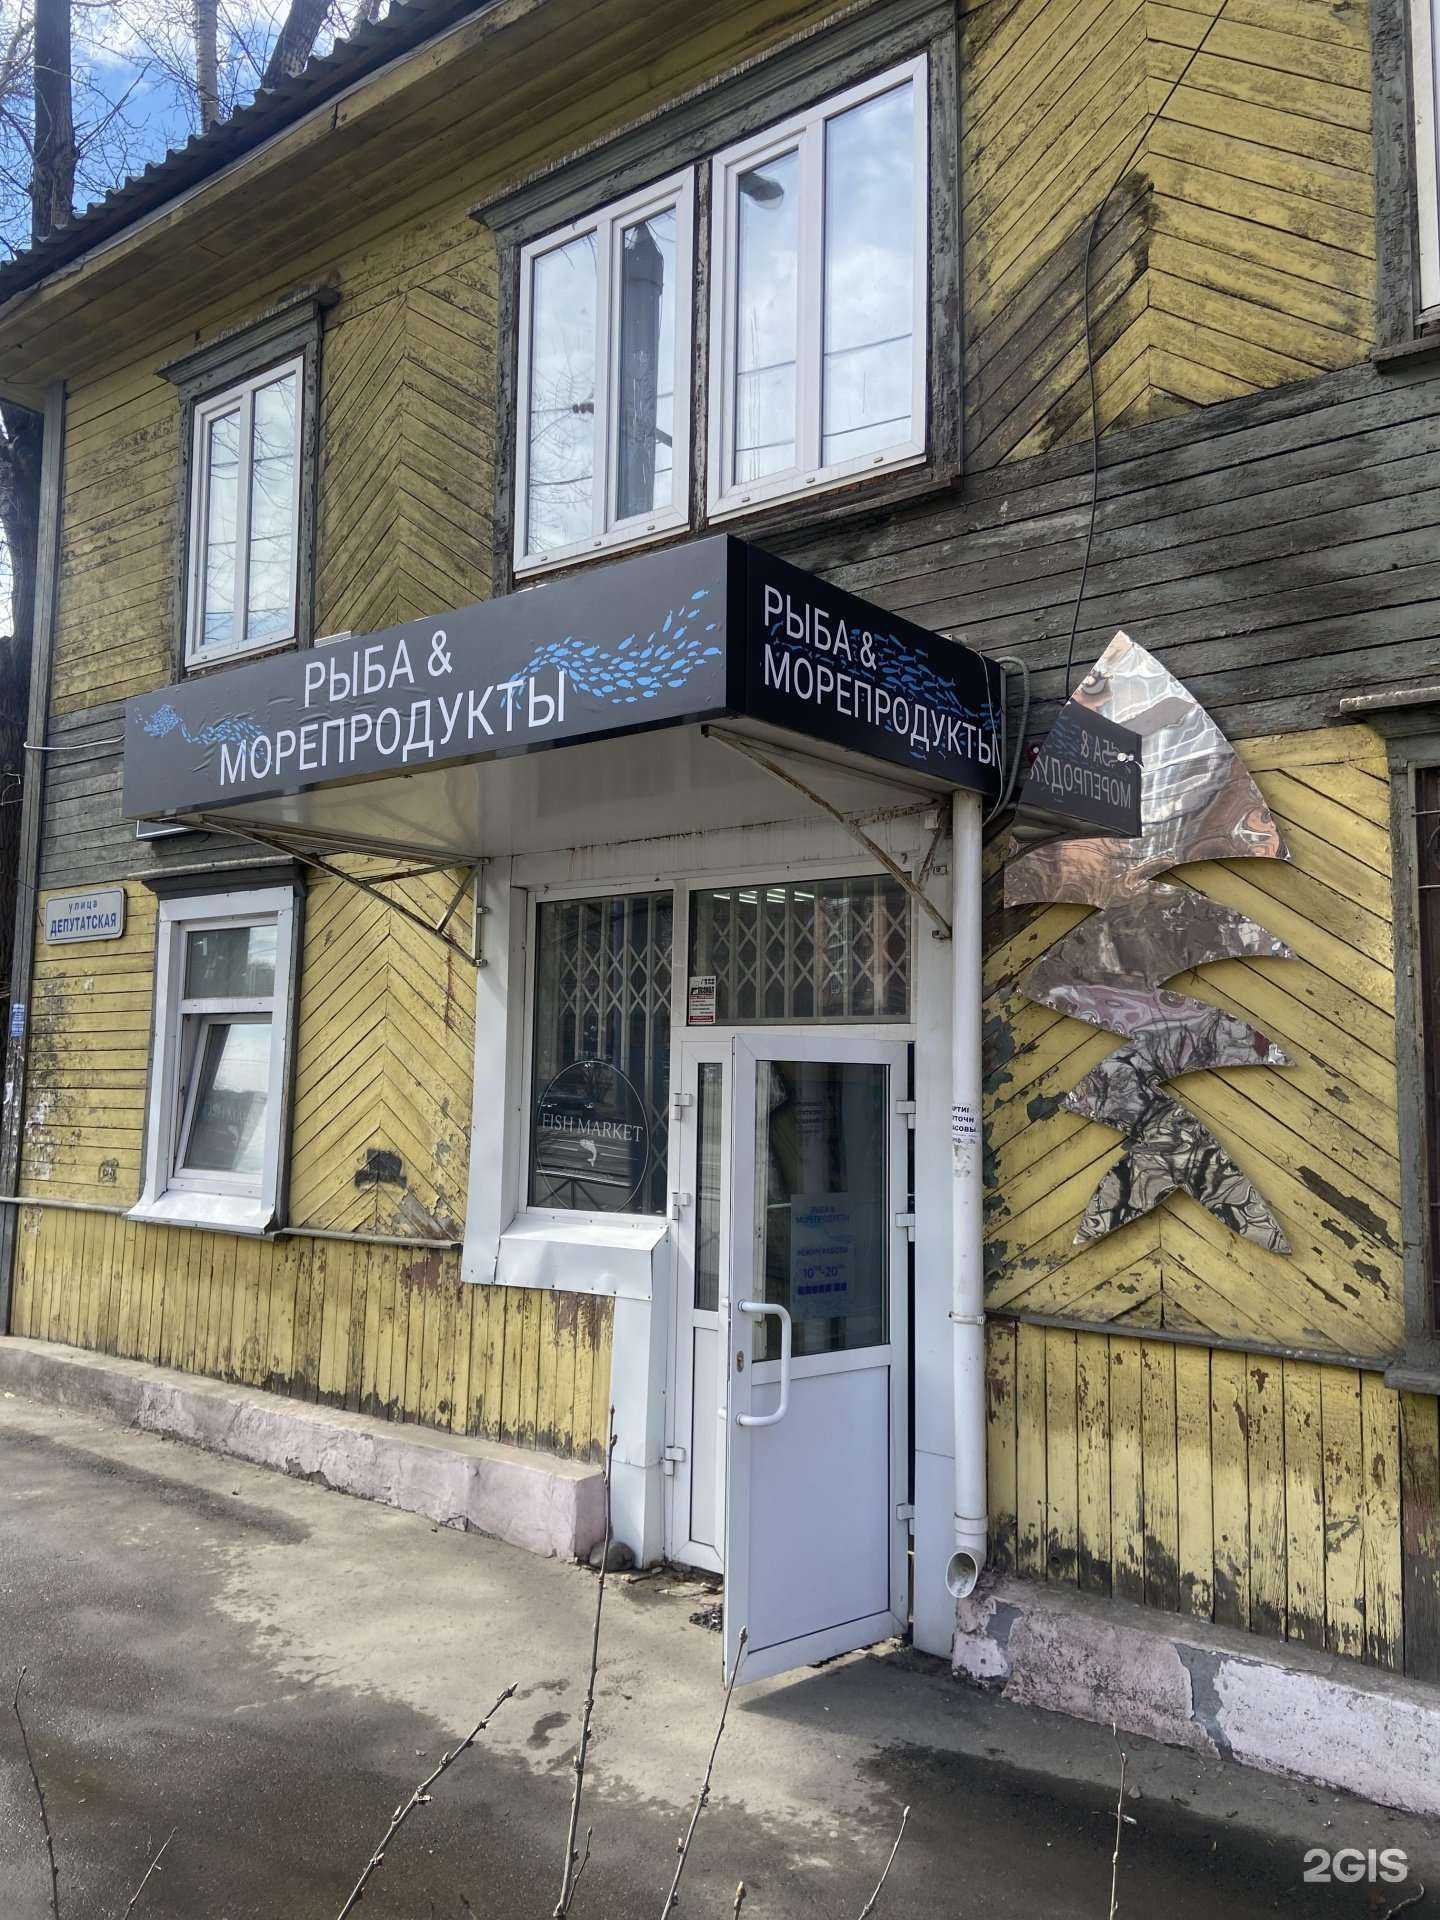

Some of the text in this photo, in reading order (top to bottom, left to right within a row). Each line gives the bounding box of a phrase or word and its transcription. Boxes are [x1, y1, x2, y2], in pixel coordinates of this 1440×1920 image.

[764, 583, 877, 670] РЫБА &
[304, 629, 453, 708] РЫБА &
[764, 643, 997, 767] МОРЕПРОДУКТЫ
[218, 670, 567, 787] МОРЕПРОДУКТЫ
[50, 912, 117, 938] ДЕПУТАТСКАЯ
[68, 899, 98, 913] улица
[542, 1113, 644, 1142] FISH MARKET
